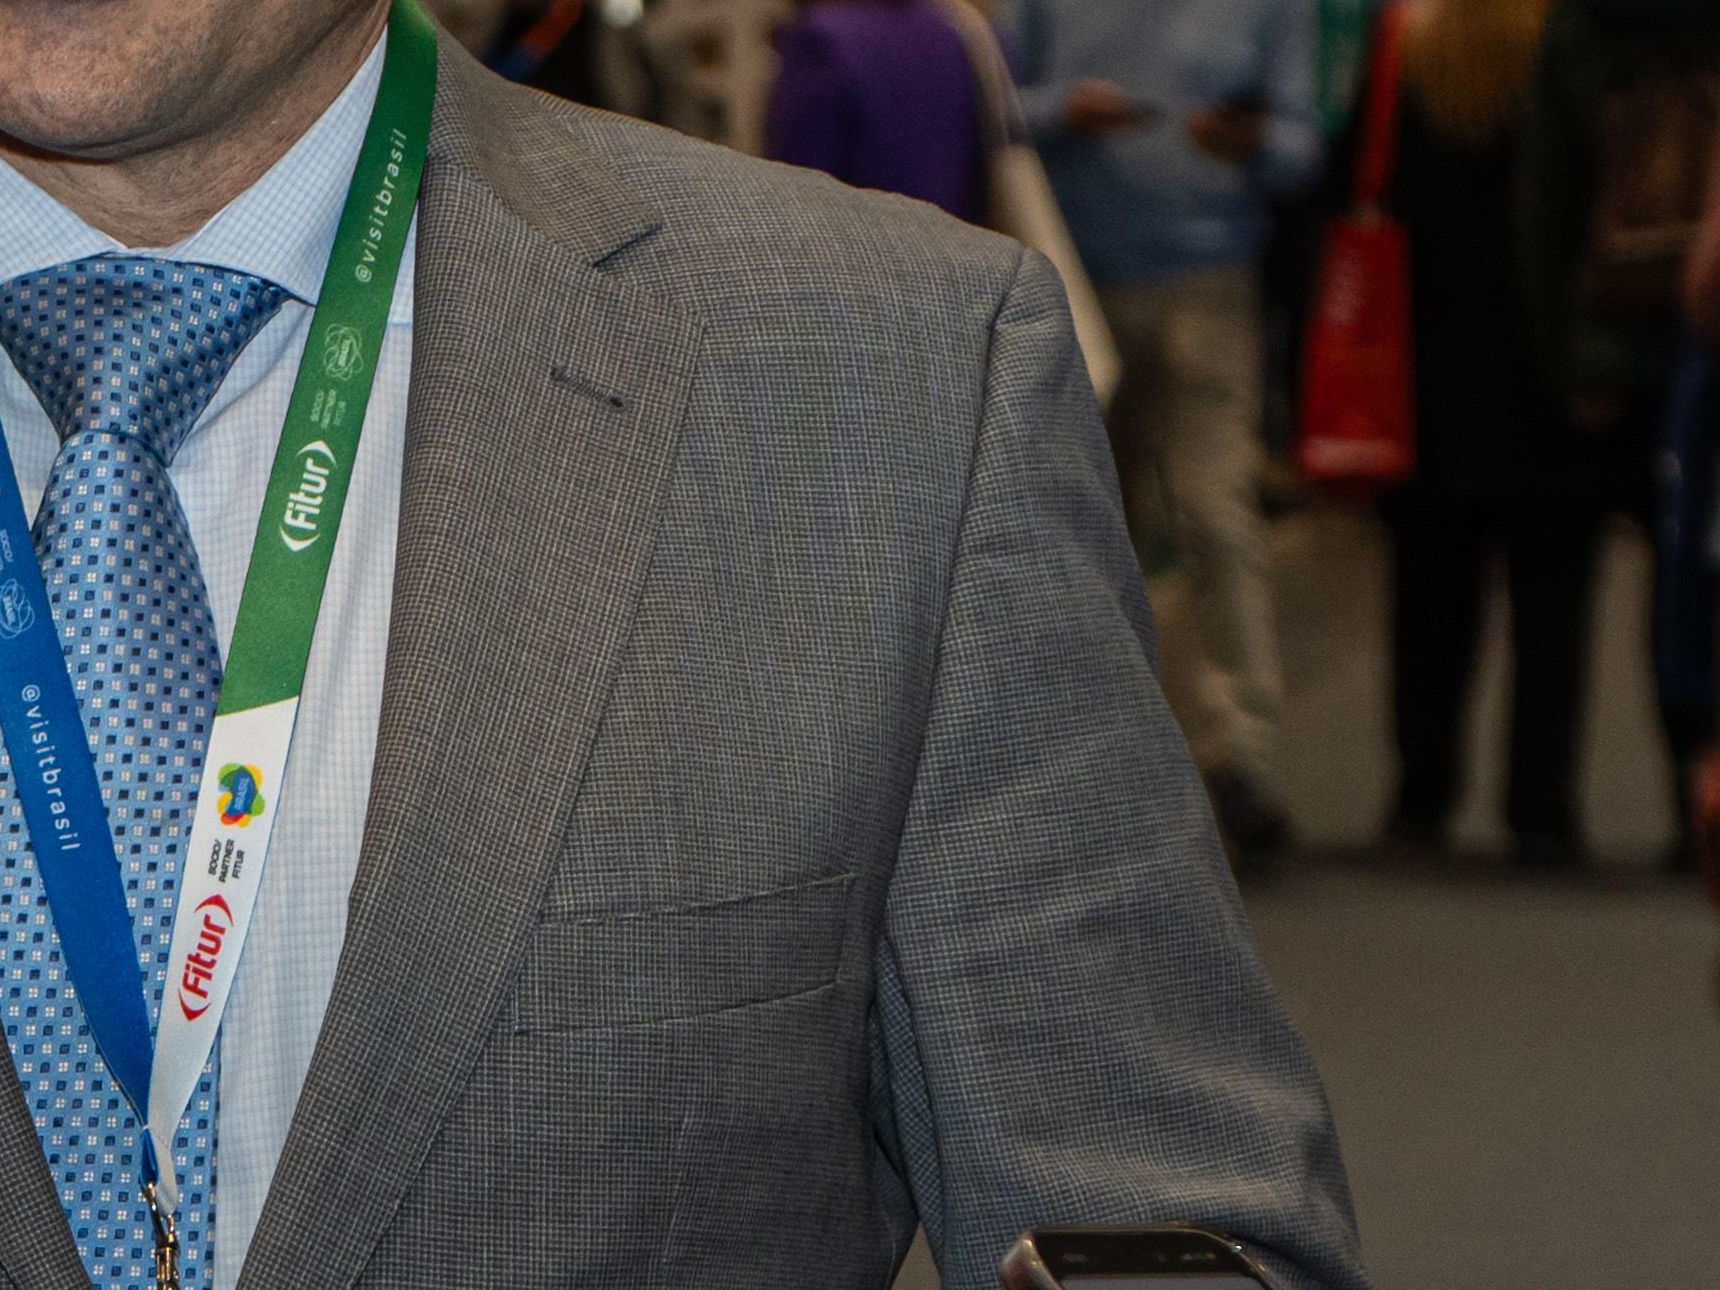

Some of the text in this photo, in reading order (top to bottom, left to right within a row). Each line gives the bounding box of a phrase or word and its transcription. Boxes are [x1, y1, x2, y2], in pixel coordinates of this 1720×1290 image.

[355, 127, 408, 283] @visitbrasil
[21, 683, 81, 851] @visitbrasil
[208, 838, 222, 876] SOCIO/
[218, 838, 235, 884] PARTNER
[232, 849, 246, 879] FITUR
